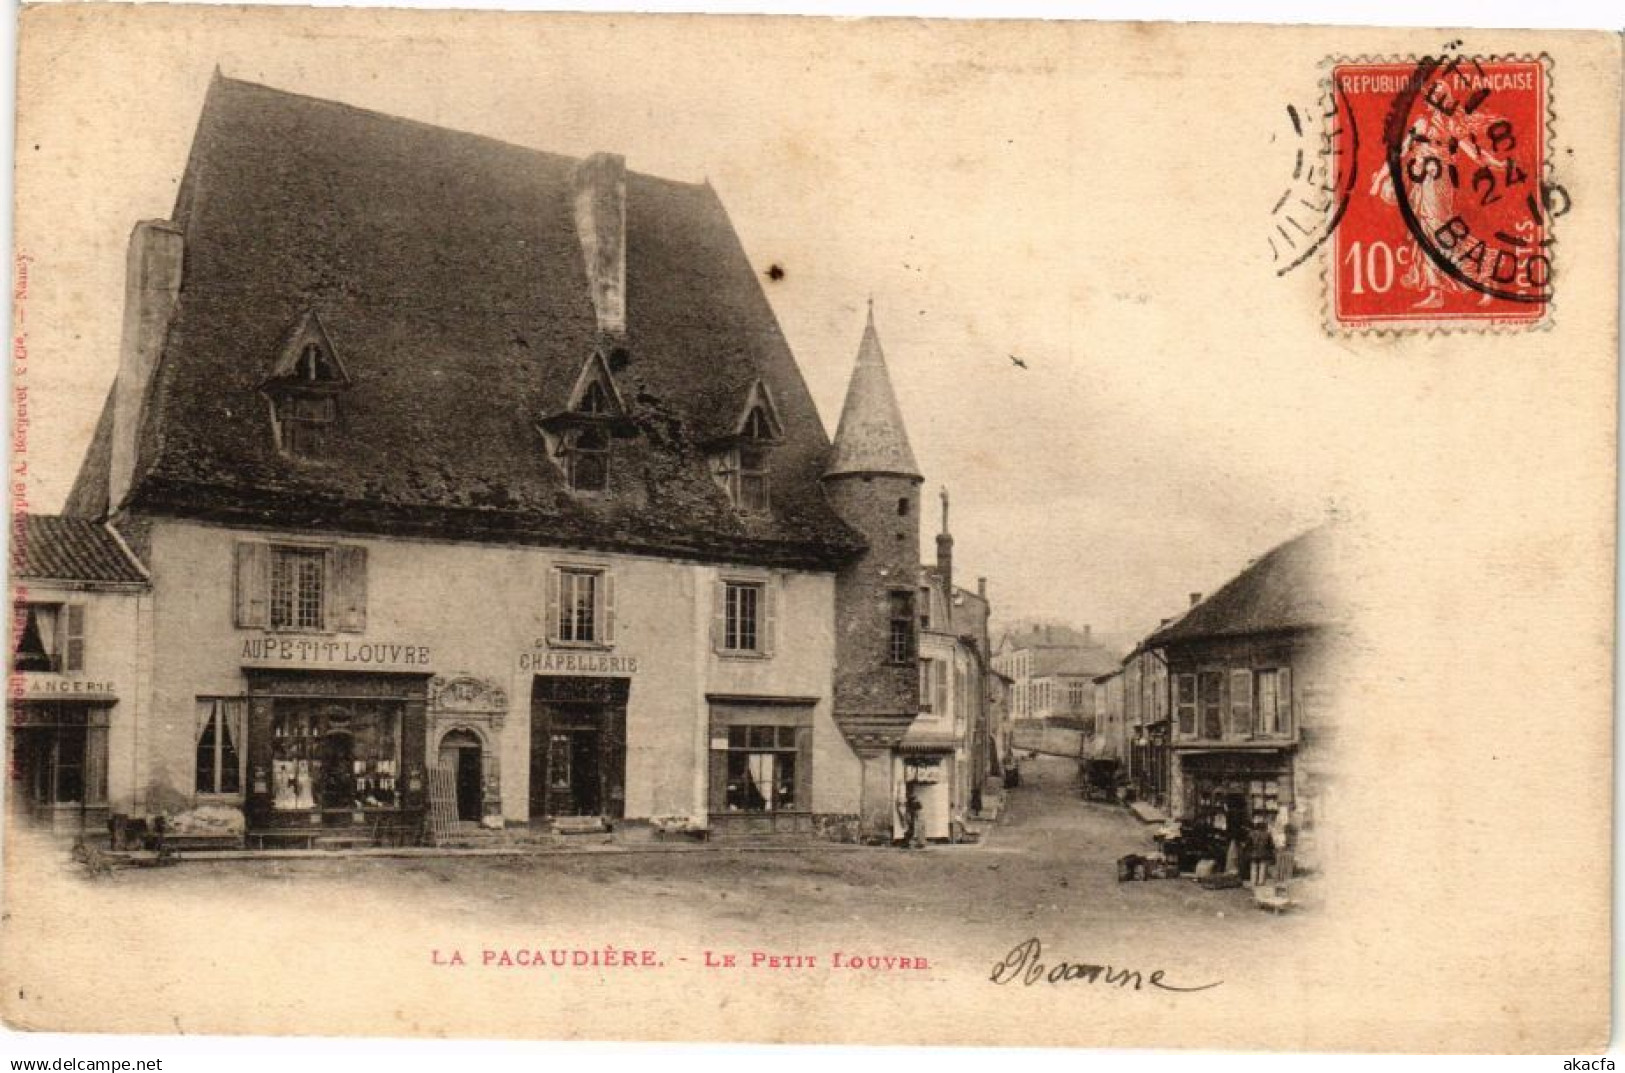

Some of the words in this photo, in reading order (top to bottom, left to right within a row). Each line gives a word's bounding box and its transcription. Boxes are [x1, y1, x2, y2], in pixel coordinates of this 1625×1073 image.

[1341, 74, 1429, 96] REPUBLIQ
[1472, 156, 1528, 206] 24
[242, 639, 263, 659] AU
[263, 638, 340, 662] PETIT
[344, 643, 430, 664] LOUVRE
[520, 653, 638, 673] CHAPELLERIE
